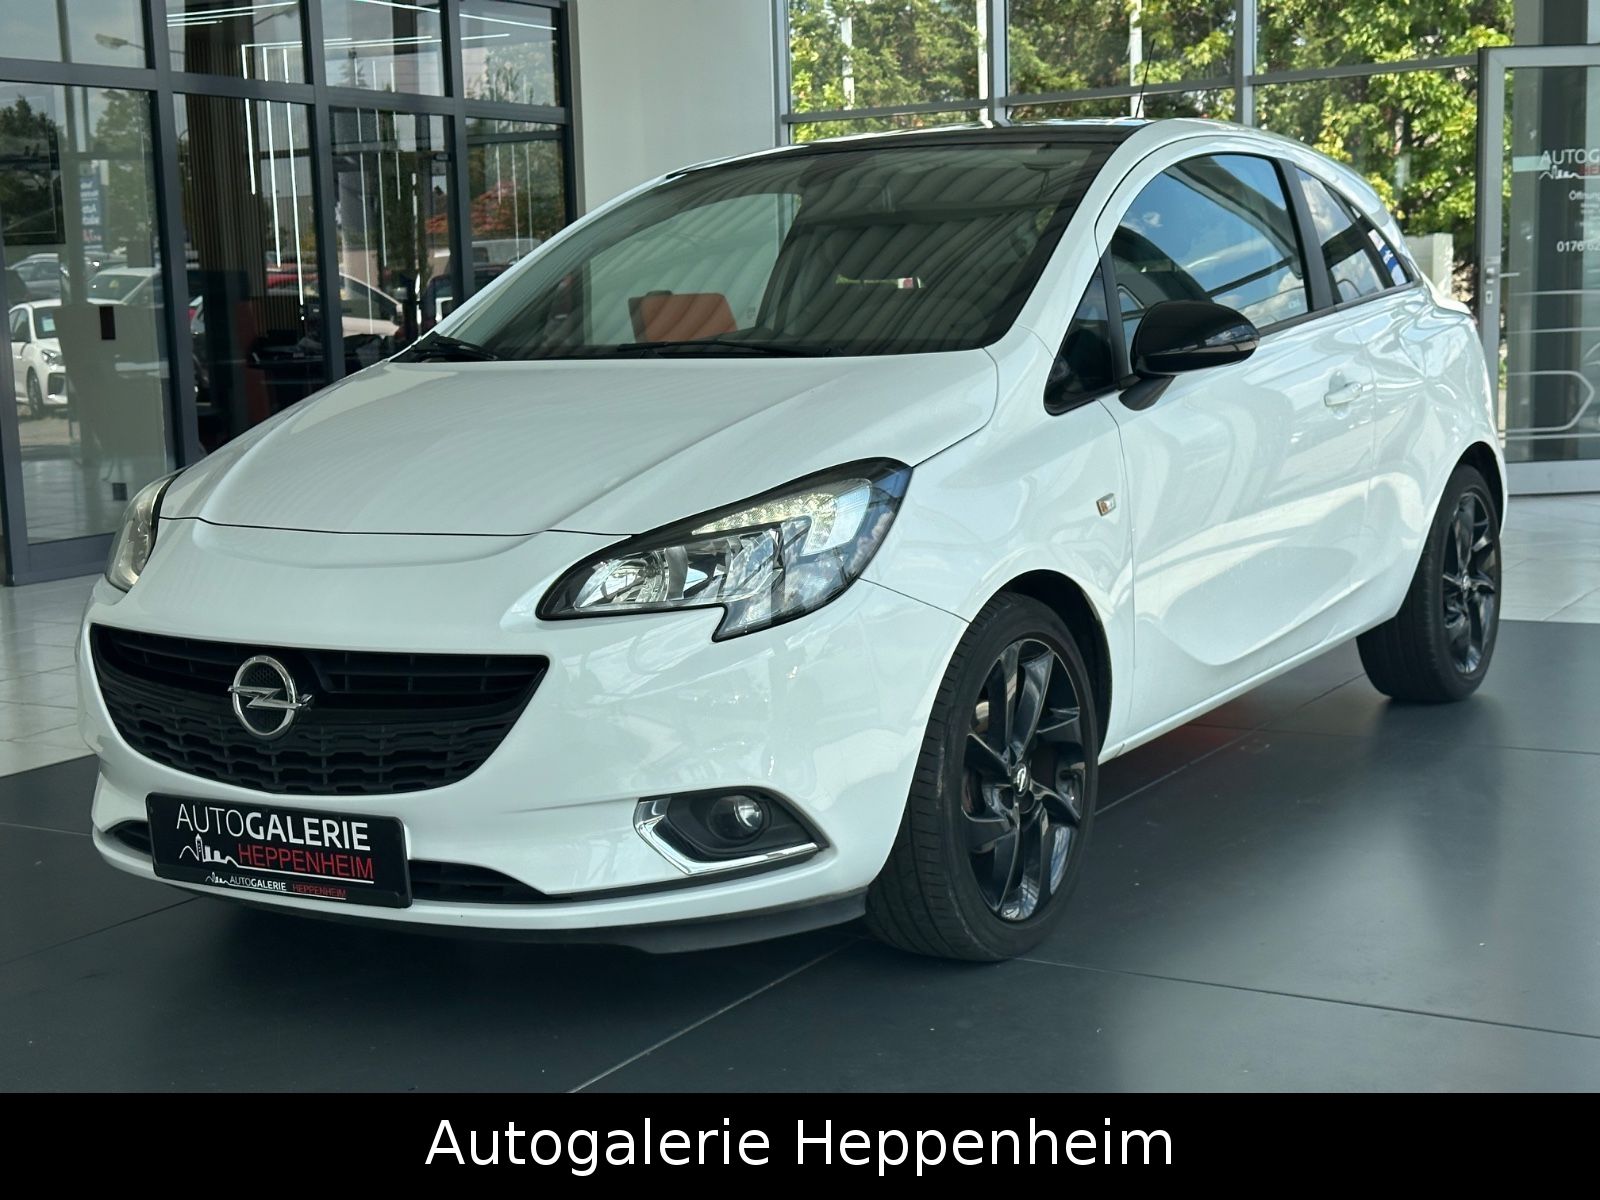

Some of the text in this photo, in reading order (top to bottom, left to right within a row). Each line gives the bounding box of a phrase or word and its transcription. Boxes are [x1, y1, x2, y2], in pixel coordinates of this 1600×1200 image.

[1556, 241, 1585, 252] 0176
[176, 803, 371, 851] AUTOGALERIE
[237, 843, 375, 880] HEPPENHEIM
[229, 875, 347, 898] AUTOGALERIE HEPPENHEIM
